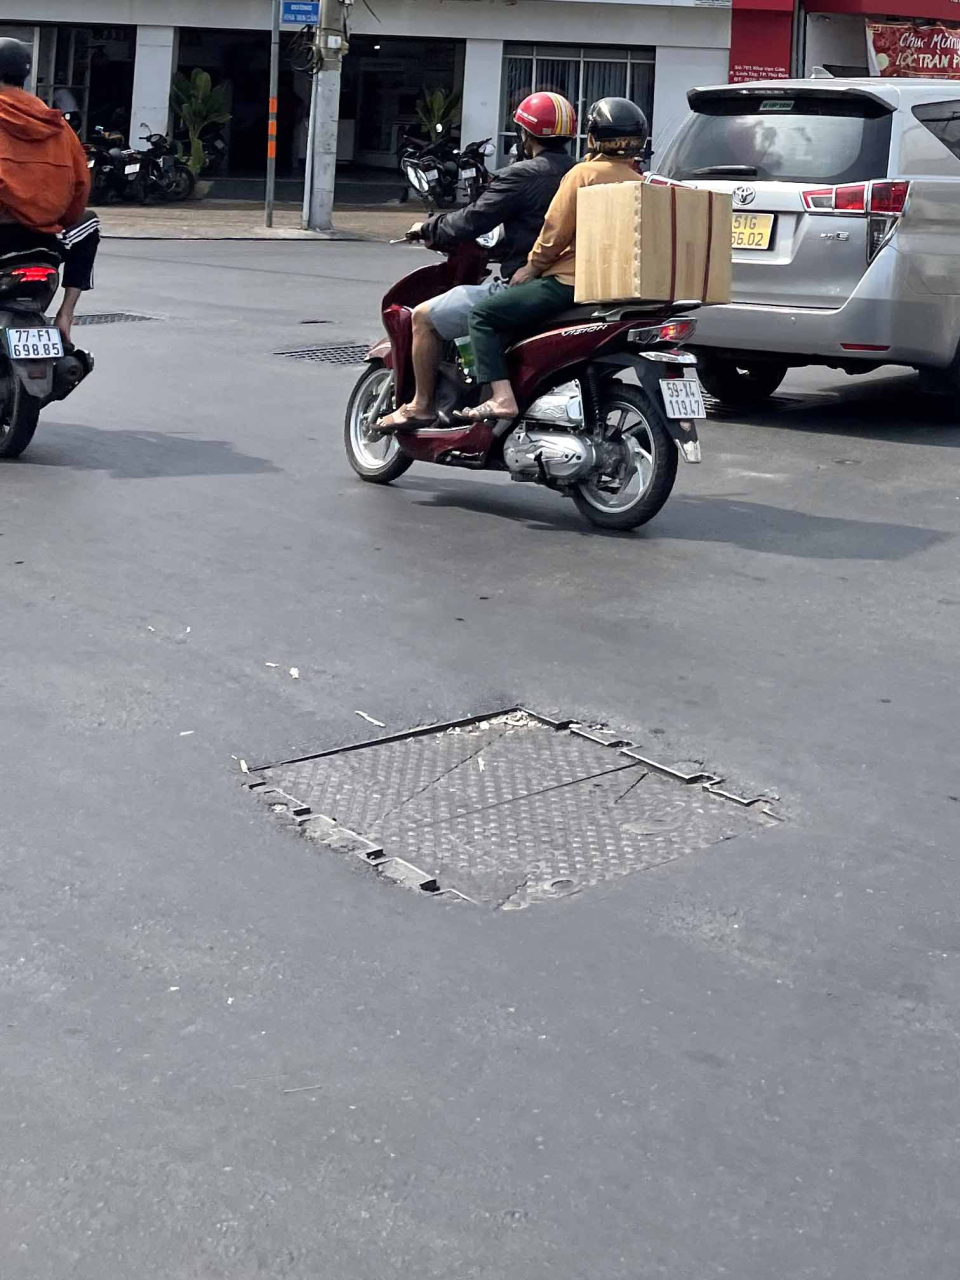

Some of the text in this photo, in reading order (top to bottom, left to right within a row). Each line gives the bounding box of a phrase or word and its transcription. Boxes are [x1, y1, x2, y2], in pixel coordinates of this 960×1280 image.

[733, 214, 758, 230] 51G
[15, 330, 51, 343] 77-F1
[13, 343, 60, 357] 698.85
[666, 382, 696, 400] 59-X4
[669, 400, 700, 417] 119.47
